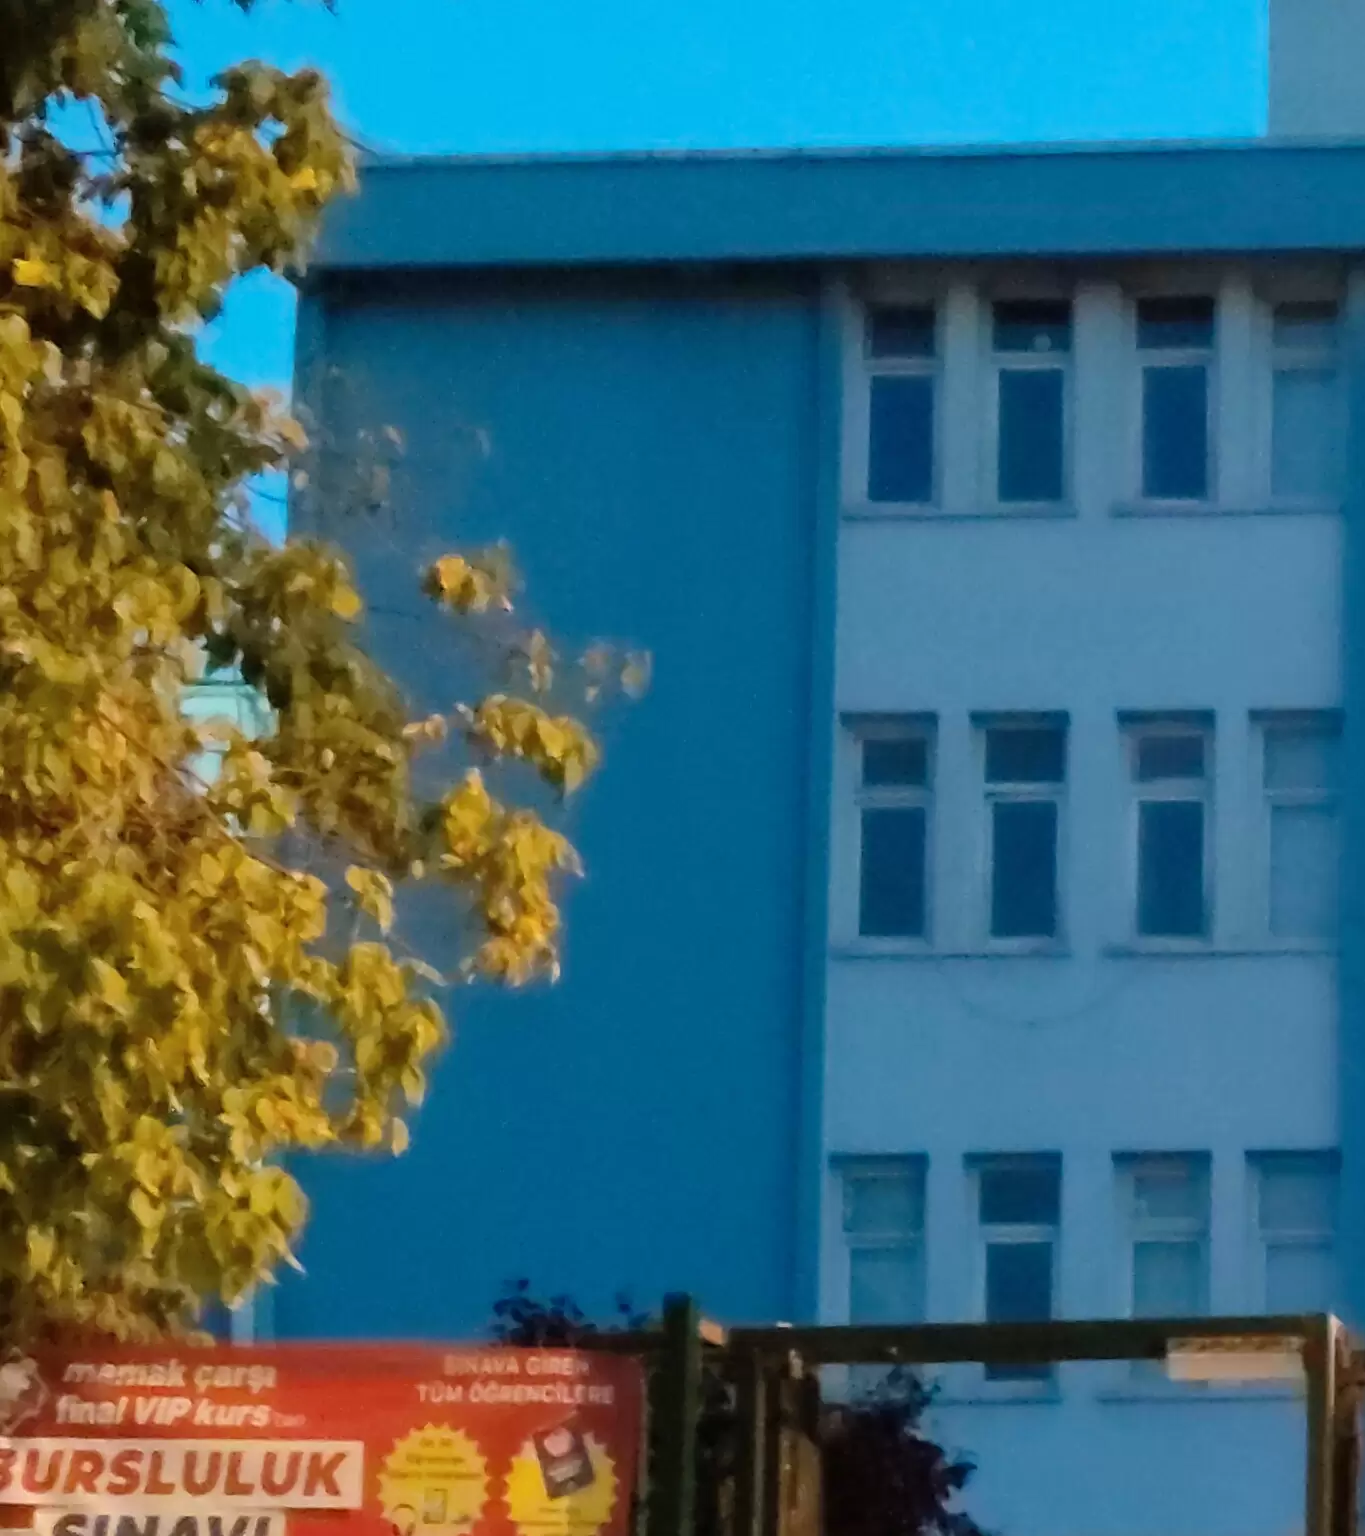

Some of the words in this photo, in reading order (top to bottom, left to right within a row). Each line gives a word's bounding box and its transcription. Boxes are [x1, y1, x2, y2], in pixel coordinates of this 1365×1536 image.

[417, 1379, 463, 1404] TÜM
[56, 1395, 130, 1426] final
[135, 1397, 193, 1427] VIP
[194, 1398, 272, 1428] kurs
